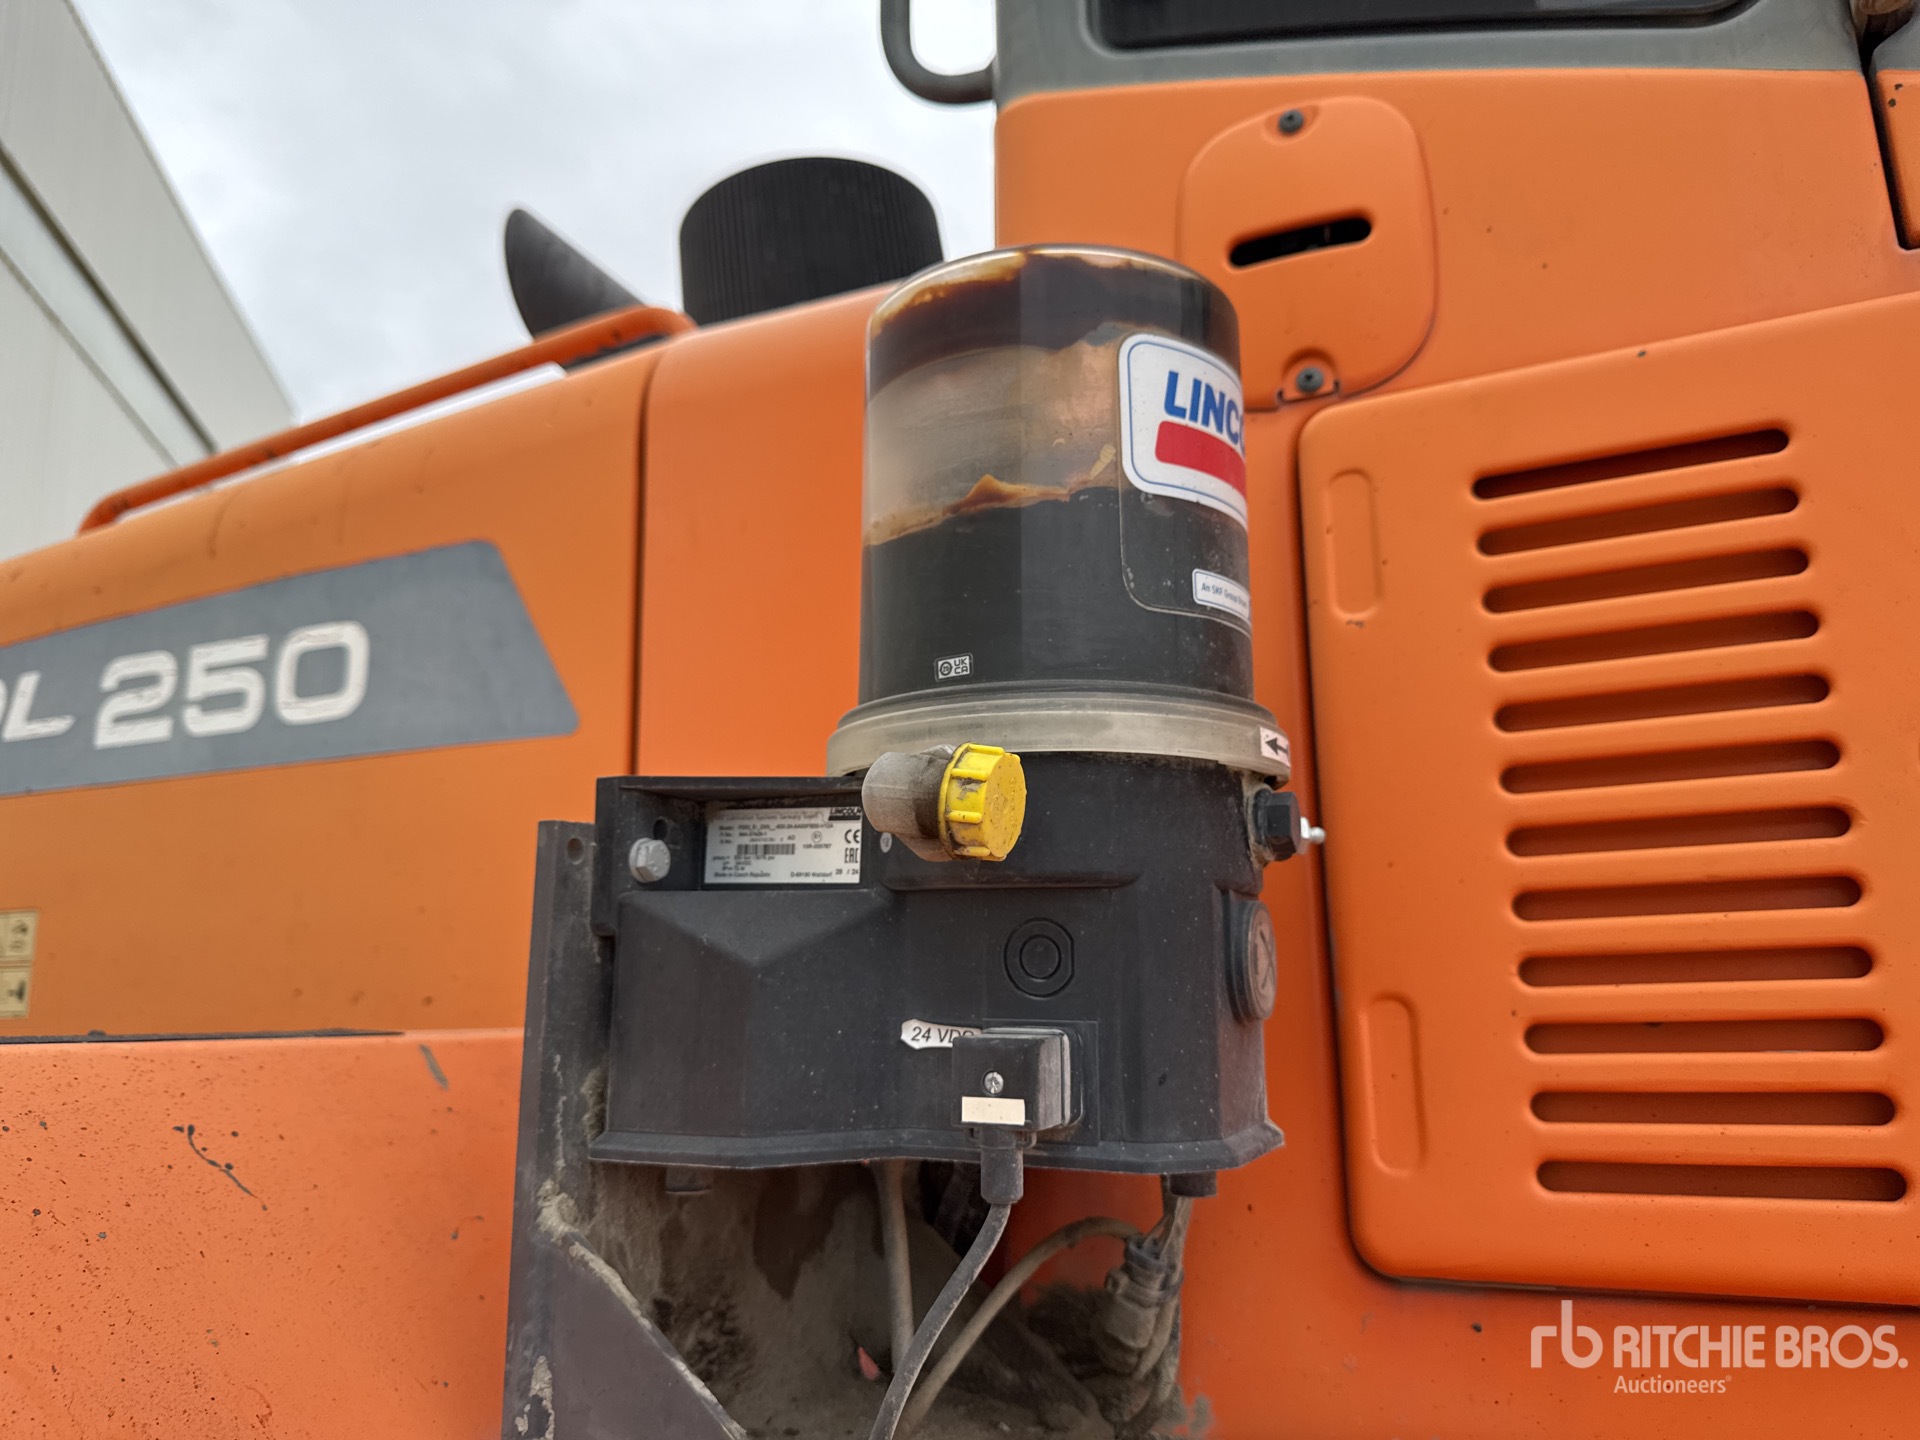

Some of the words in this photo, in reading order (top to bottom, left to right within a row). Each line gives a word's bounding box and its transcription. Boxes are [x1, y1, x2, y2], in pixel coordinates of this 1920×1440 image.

[1163, 370, 1246, 458] LINC
[1201, 582, 1210, 592] An
[1211, 584, 1223, 596] SKF
[953, 658, 967, 666] UK
[954, 666, 968, 674] CA
[93, 619, 371, 751] 250
[844, 847, 859, 864] EAC
[911, 1026, 932, 1043] 24
